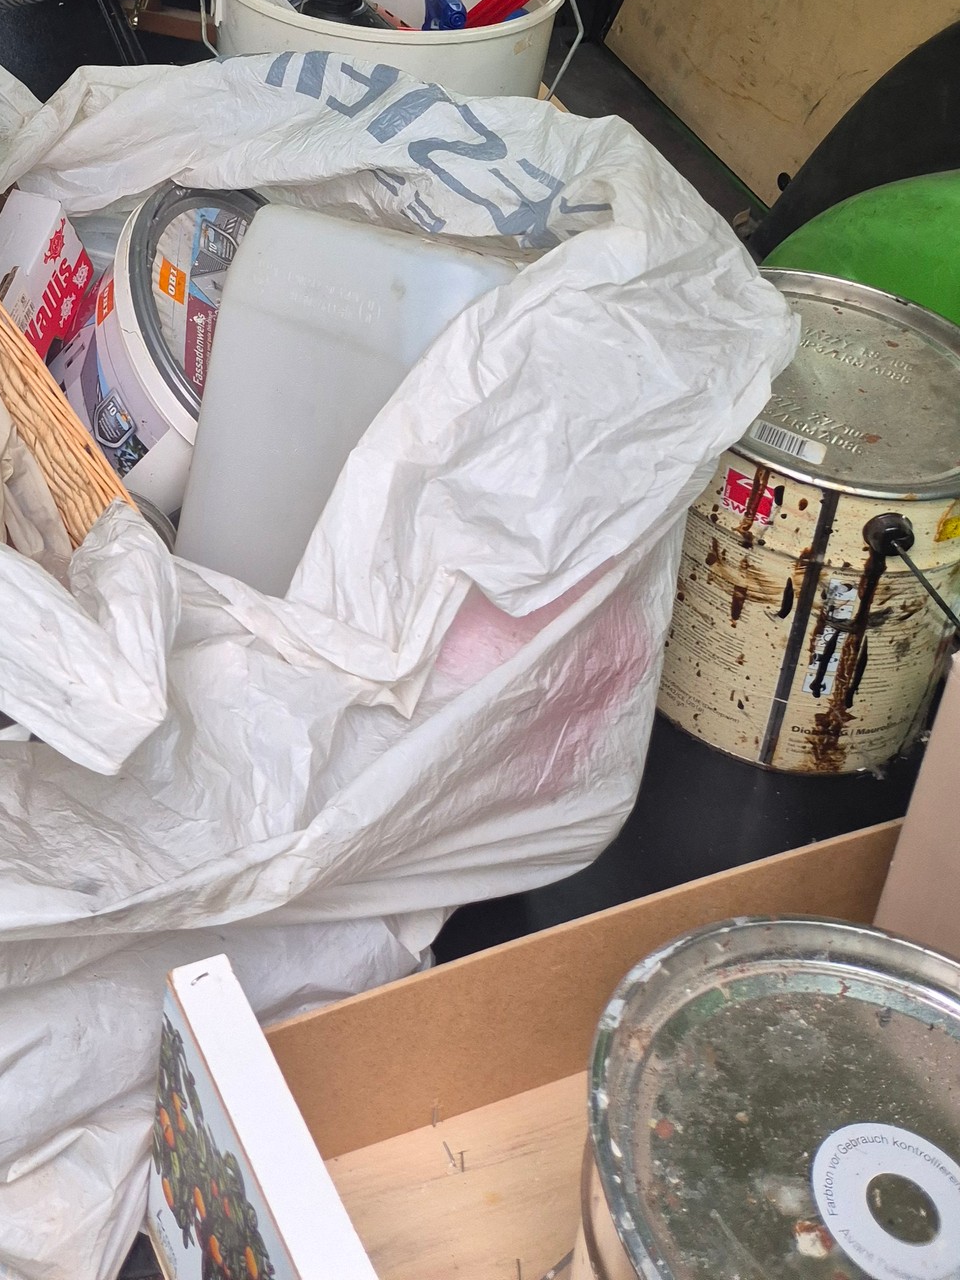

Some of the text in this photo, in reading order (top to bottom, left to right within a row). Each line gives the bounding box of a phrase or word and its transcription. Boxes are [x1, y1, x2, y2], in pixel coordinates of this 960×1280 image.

[167, 268, 178, 296] OBI
[723, 497, 774, 527] SWSS
[836, 1134, 889, 1155] Gebrauch
[828, 1153, 841, 1171] vor
[823, 1171, 839, 1217] Farbton
